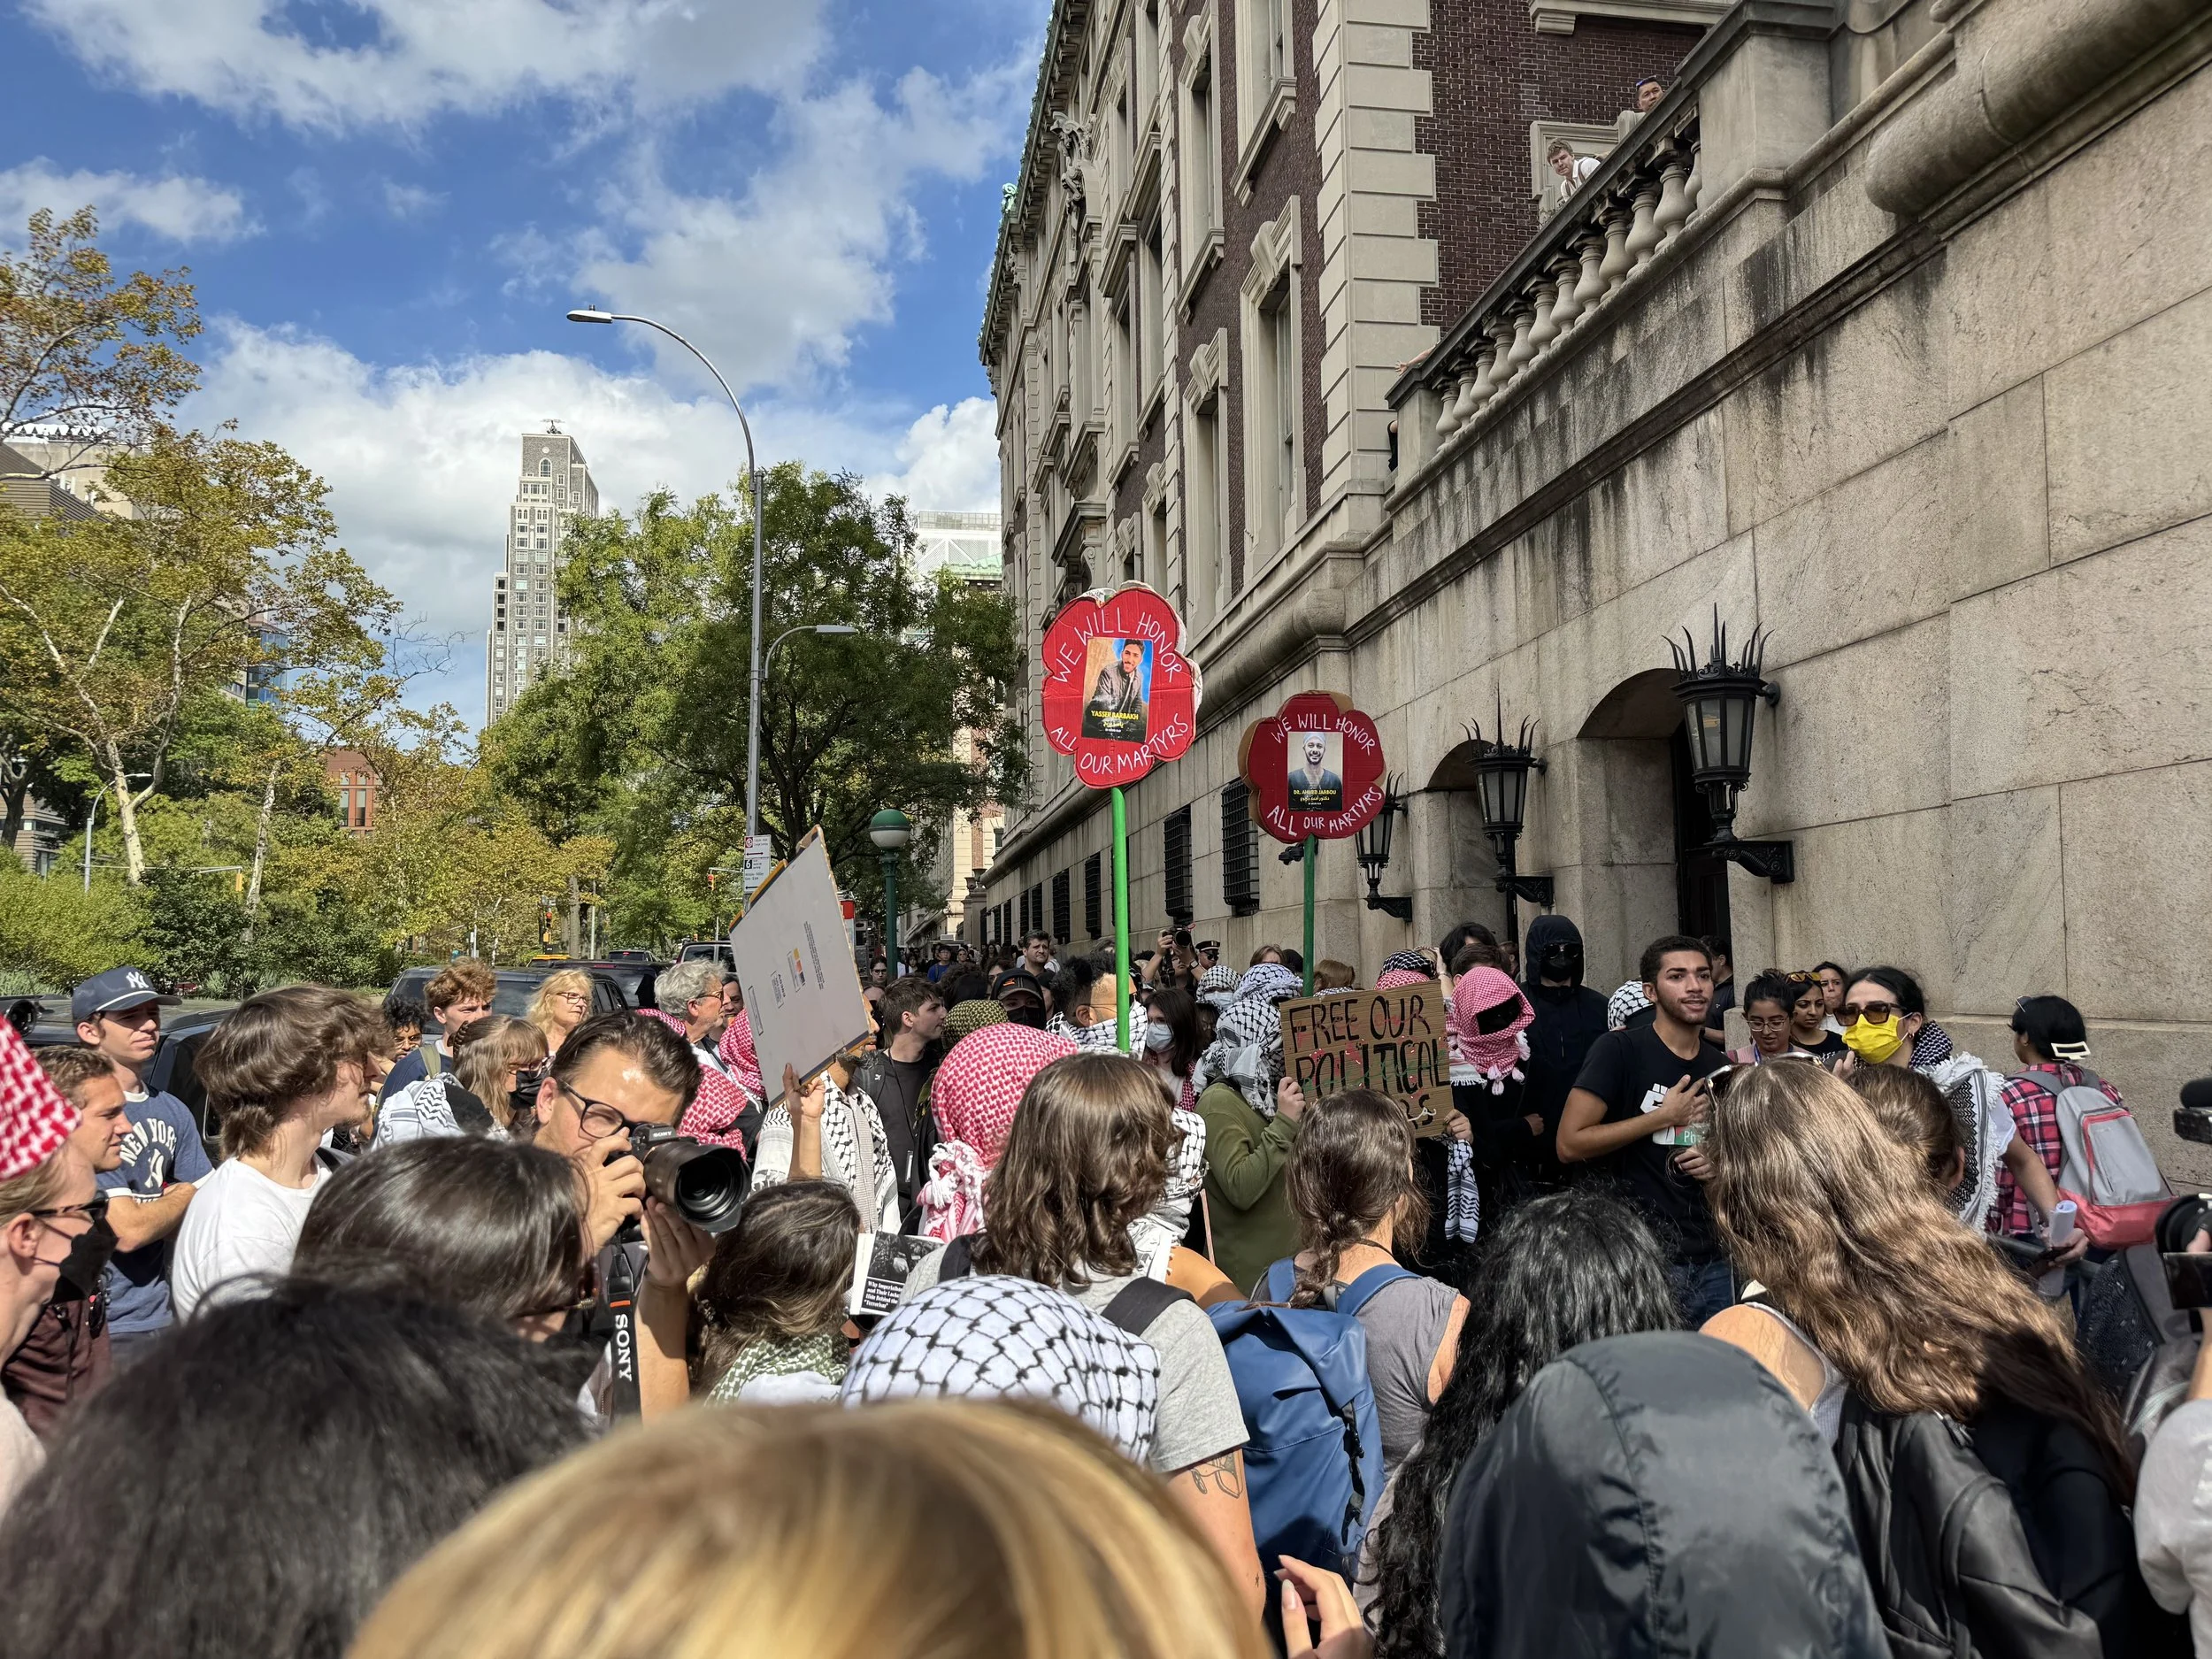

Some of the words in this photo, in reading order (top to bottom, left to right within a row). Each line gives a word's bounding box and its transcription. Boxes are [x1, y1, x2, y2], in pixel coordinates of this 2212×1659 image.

[1052, 641, 1082, 683] WE
[1073, 607, 1131, 647] WILL
[1135, 611, 1183, 683] HONOR
[1050, 726, 1078, 752] ALL
[1079, 752, 1113, 775] OUR
[1117, 712, 1189, 774] MARTYRS
[1271, 716, 1292, 744] WE
[1297, 713, 1332, 730] WILL
[1335, 717, 1376, 757] HONOR
[1266, 805, 1297, 837] ALL
[1303, 817, 1325, 830] OUR
[1329, 787, 1382, 833] MARTYRS
[1289, 998, 1360, 1053] FREE
[1371, 995, 1432, 1041] OUR
[119, 1121, 150, 1167] NEW
[615, 1314, 633, 1382] SONY
